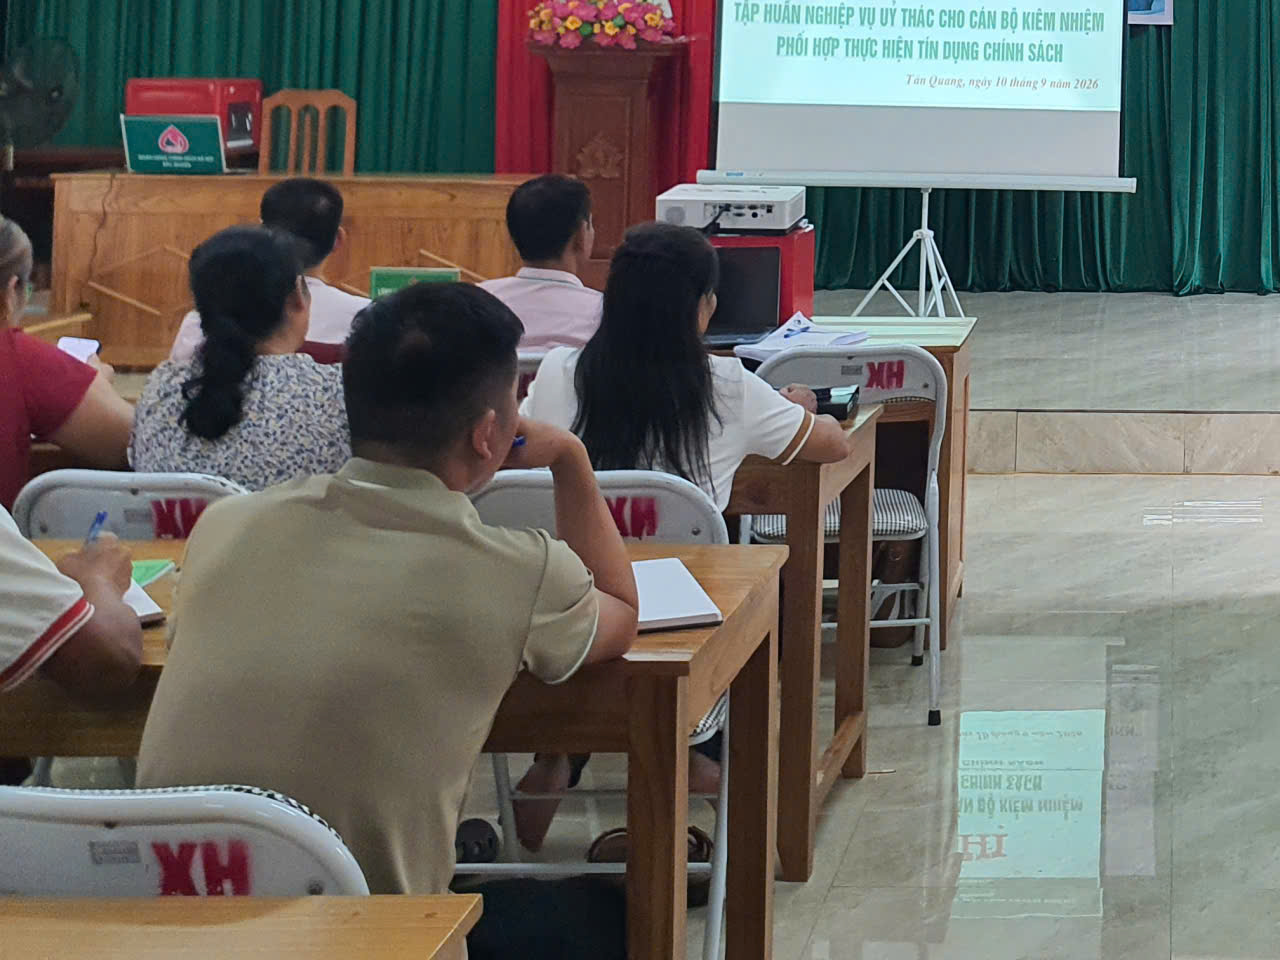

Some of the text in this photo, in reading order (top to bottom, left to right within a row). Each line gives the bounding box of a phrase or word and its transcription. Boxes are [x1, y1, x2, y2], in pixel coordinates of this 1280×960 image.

[805, 2, 855, 29] NGHIỆP
[859, 6, 875, 30] VỤ
[901, 4, 934, 28] THÁC
[939, 8, 965, 29] CHO
[969, 6, 996, 30] CÁN
[1000, 7, 1018, 34] BỘ
[1022, 8, 1055, 32] KIÊM
[1059, 8, 1105, 35] NHIỆM
[776, 30, 1063, 64] PHỐI HỢP THỰC HIỆN TÍN DỤNG CHÍNH SÁCH
[996, 76, 1008, 87] 10
[1009, 76, 1039, 90] tháng
[865, 360, 904, 389] XH
[151, 841, 252, 897] XH
